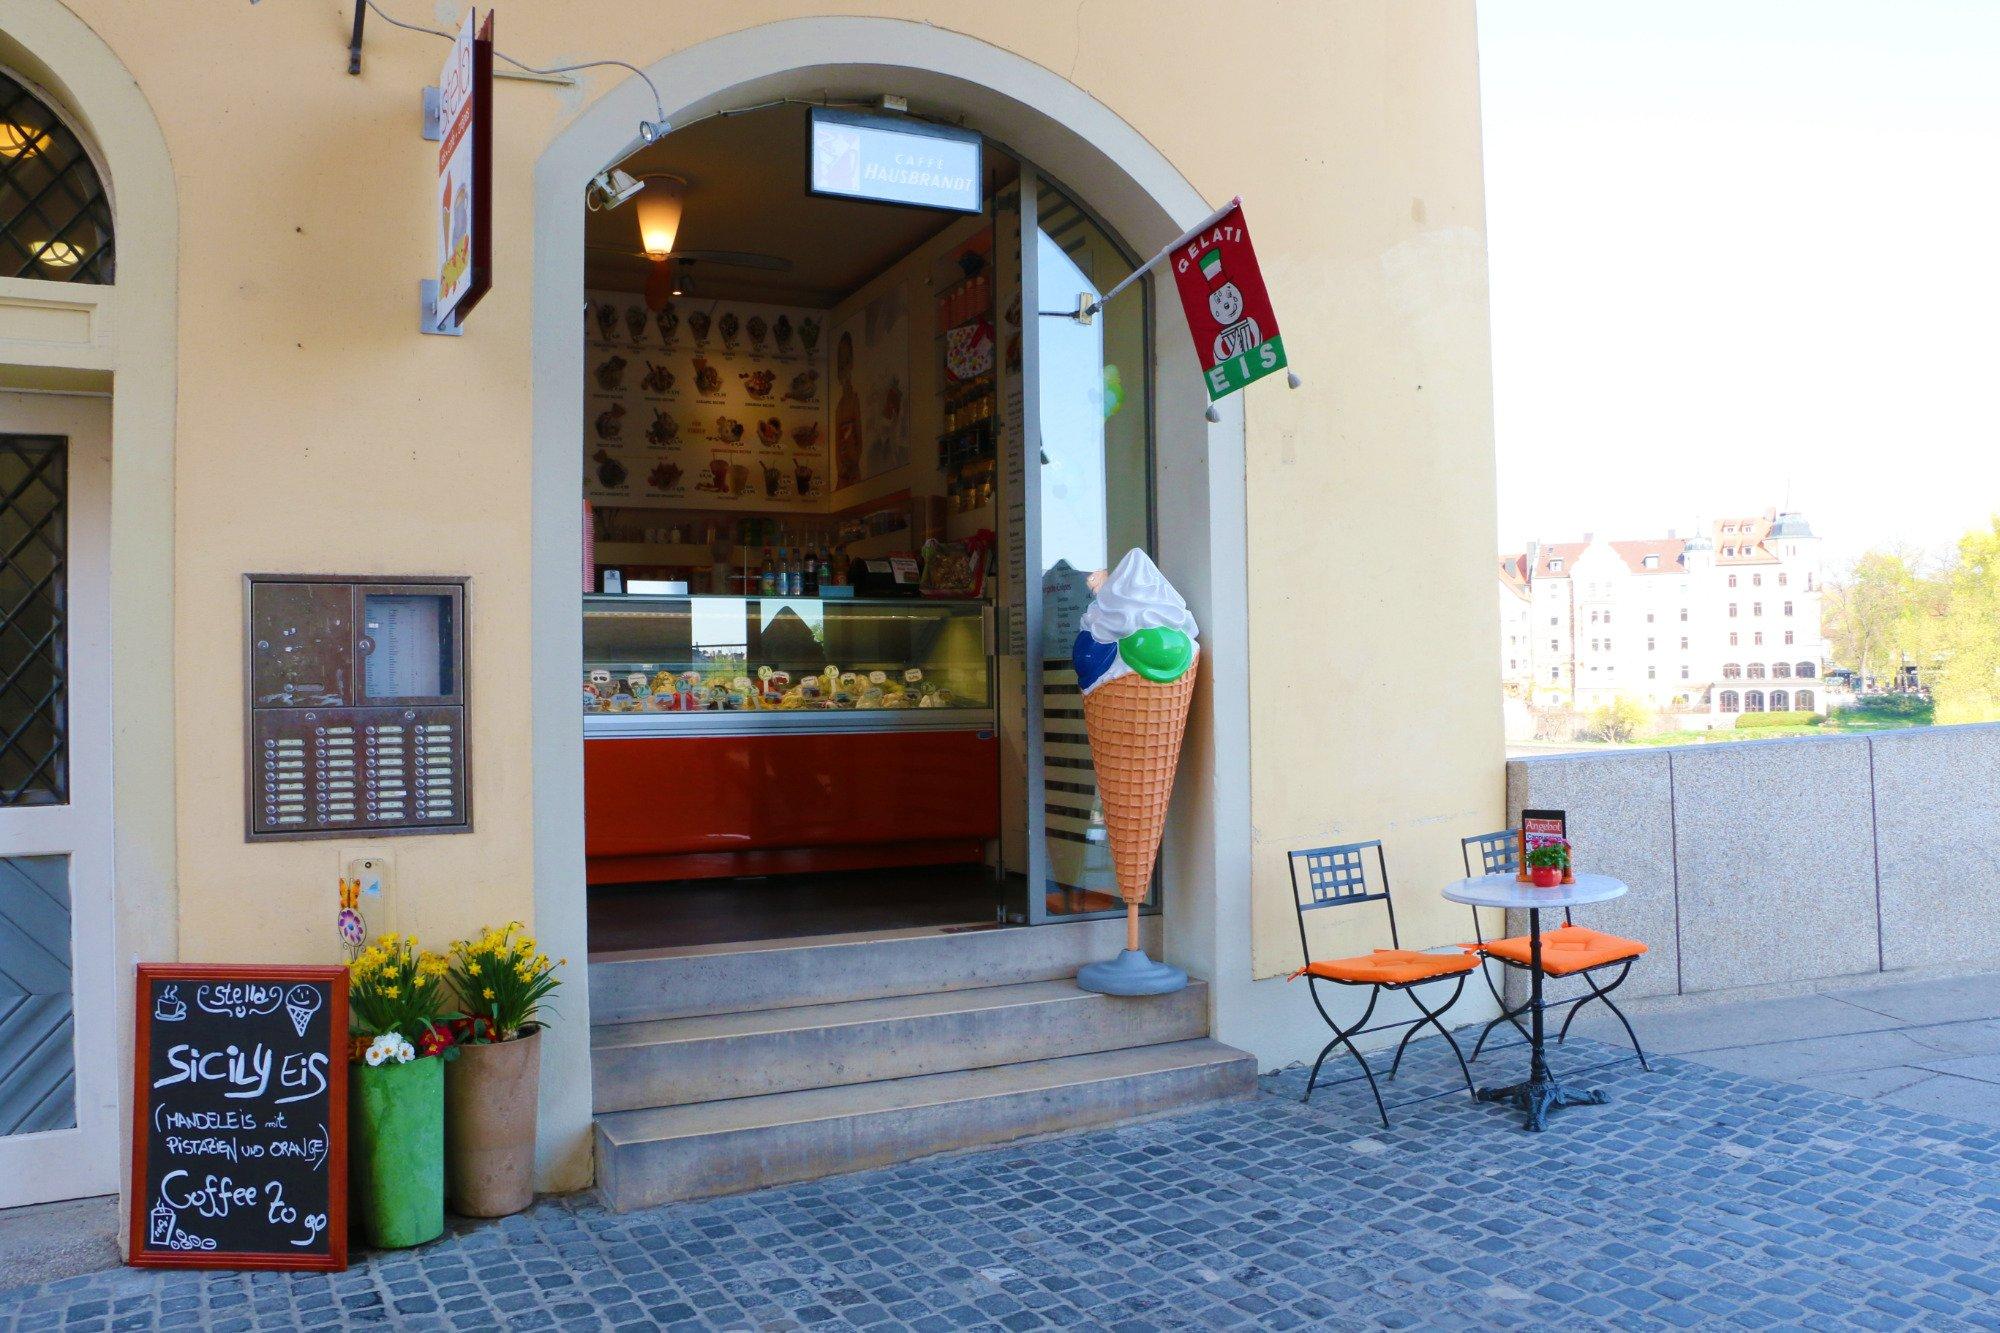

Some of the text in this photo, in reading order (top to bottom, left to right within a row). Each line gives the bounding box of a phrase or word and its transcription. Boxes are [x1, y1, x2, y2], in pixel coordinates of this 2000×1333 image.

[864, 163, 974, 192] HAUSBRANDT
[1178, 226, 1242, 274] GELATI
[1209, 343, 1277, 392] EIS
[264, 1112, 287, 1129] mit
[160, 1170, 258, 1218] Coffee
[290, 1213, 327, 1246] go
